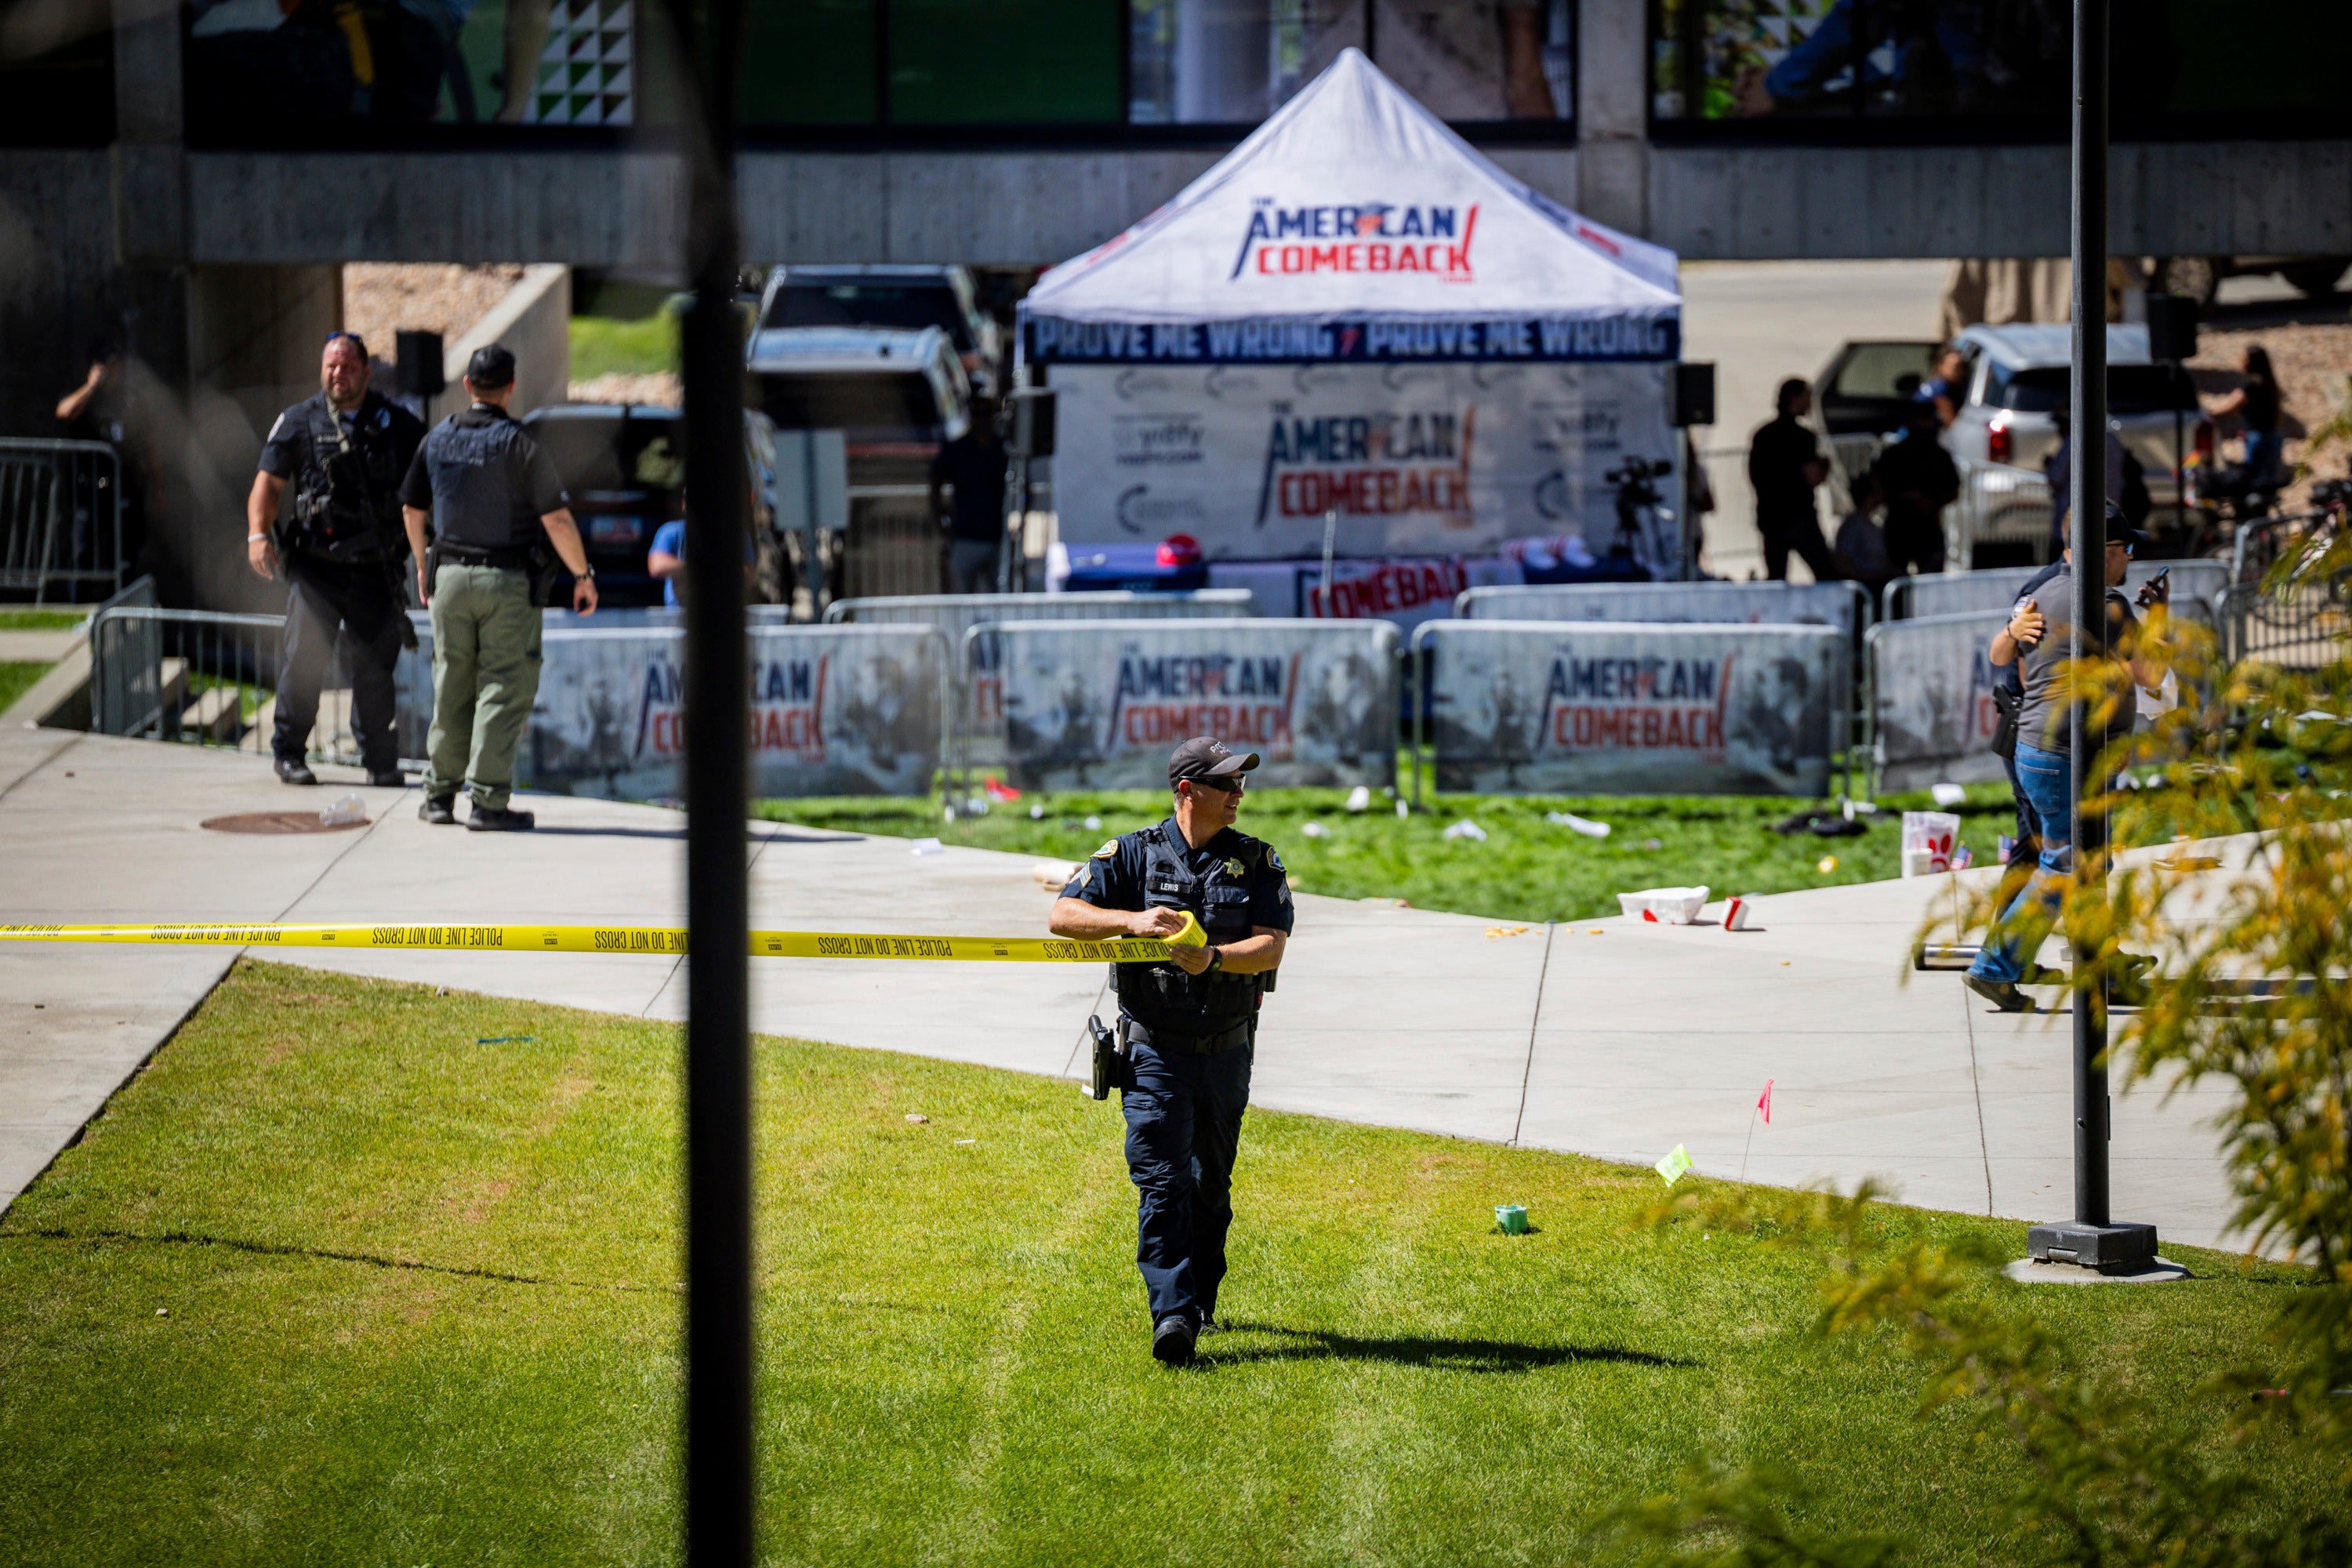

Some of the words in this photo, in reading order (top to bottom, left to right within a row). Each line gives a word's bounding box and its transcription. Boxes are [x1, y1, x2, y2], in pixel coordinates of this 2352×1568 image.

[1035, 320, 1146, 357] PROVE
[1154, 321, 1202, 357] ME
[1208, 320, 1332, 357] WRONG
[1365, 320, 1479, 357] PROVE
[1486, 320, 1533, 356] ME
[1540, 317, 1667, 356] WRONG
[1160, 882, 1179, 892] LEWIS
[151, 925, 185, 939] CROSS
[185, 925, 207, 940] NOT
[208, 925, 223, 940] DO
[223, 925, 247, 941] LINE
[247, 925, 283, 942] POLICE
[372, 927, 405, 944] CROSS
[407, 927, 426, 945] NOT
[429, 927, 441, 945] DO
[445, 927, 466, 946] LINE
[470, 927, 503, 946] POLICE
[595, 931, 626, 949] CROSS
[630, 931, 649, 949] NOT
[652, 932, 665, 949] DO
[668, 932, 689, 950] LINE
[818, 936, 851, 954] CROSS
[855, 937, 875, 955] NOT
[876, 938, 891, 955] DO
[891, 938, 916, 956] LINE
[917, 939, 953, 956] POLICE
[1116, 941, 1142, 958] LINE
[1141, 940, 1173, 958] OLICE
[1043, 942, 1078, 959] CROSS
[1079, 942, 1099, 959] NOT
[1100, 942, 1116, 958] DO
